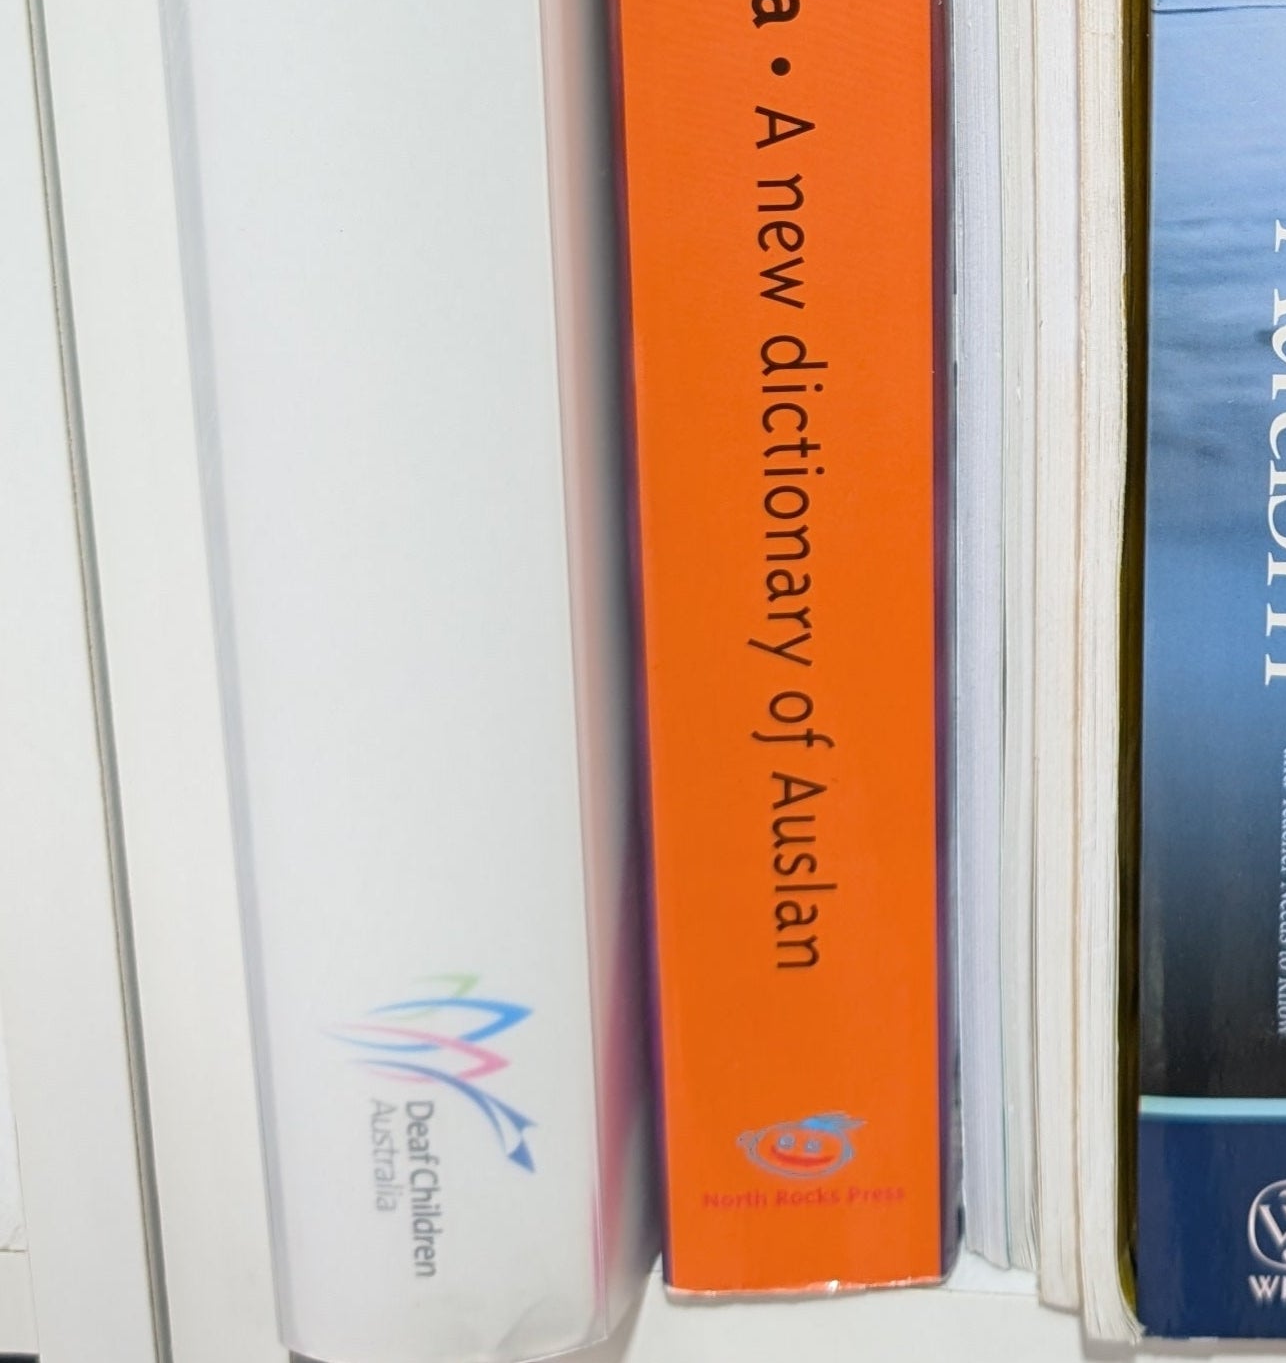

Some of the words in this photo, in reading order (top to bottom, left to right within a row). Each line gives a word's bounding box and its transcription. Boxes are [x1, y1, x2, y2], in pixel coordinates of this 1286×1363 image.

[756, 106, 816, 151] A
[757, 171, 806, 309] new
[748, 333, 829, 667] dictionary
[751, 688, 836, 750] of
[771, 770, 838, 971] Auslan
[369, 1098, 404, 1213] Australia
[405, 1099, 439, 1164] Deaf
[409, 1167, 443, 1279] Children
[704, 1189, 767, 1208] North
[776, 1188, 840, 1205] Rocks
[847, 1187, 905, 1203] Press
